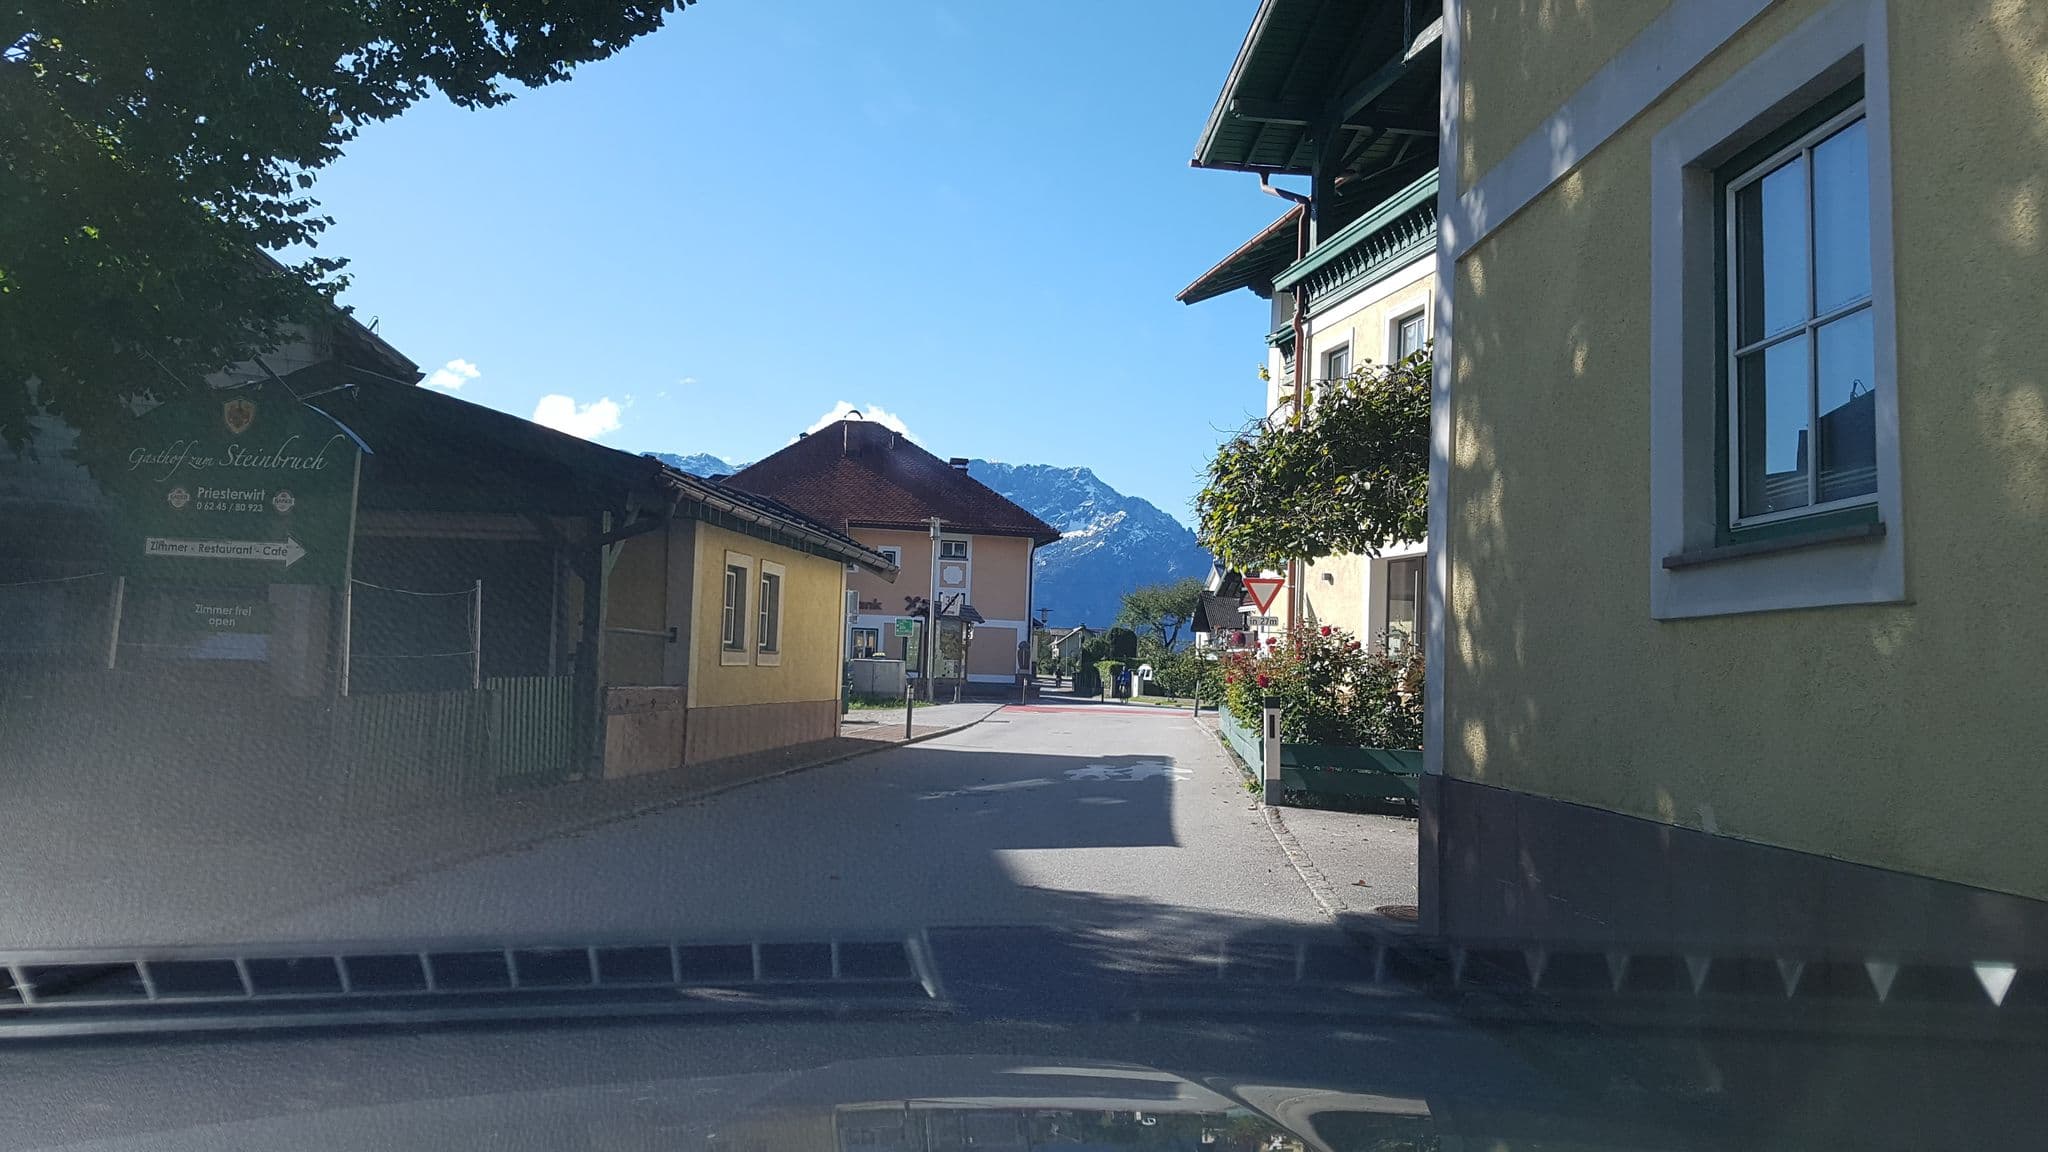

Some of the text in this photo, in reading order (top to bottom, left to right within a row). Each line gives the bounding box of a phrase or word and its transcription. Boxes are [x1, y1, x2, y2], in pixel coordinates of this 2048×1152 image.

[128, 434, 346, 482] Gasthof zum Steinbruch
[197, 487, 266, 502] Priesterwirt
[150, 540, 188, 552] Zimmer
[198, 543, 253, 555] Restaurant
[195, 604, 252, 616] Zimmer frei
[208, 617, 236, 627] open
